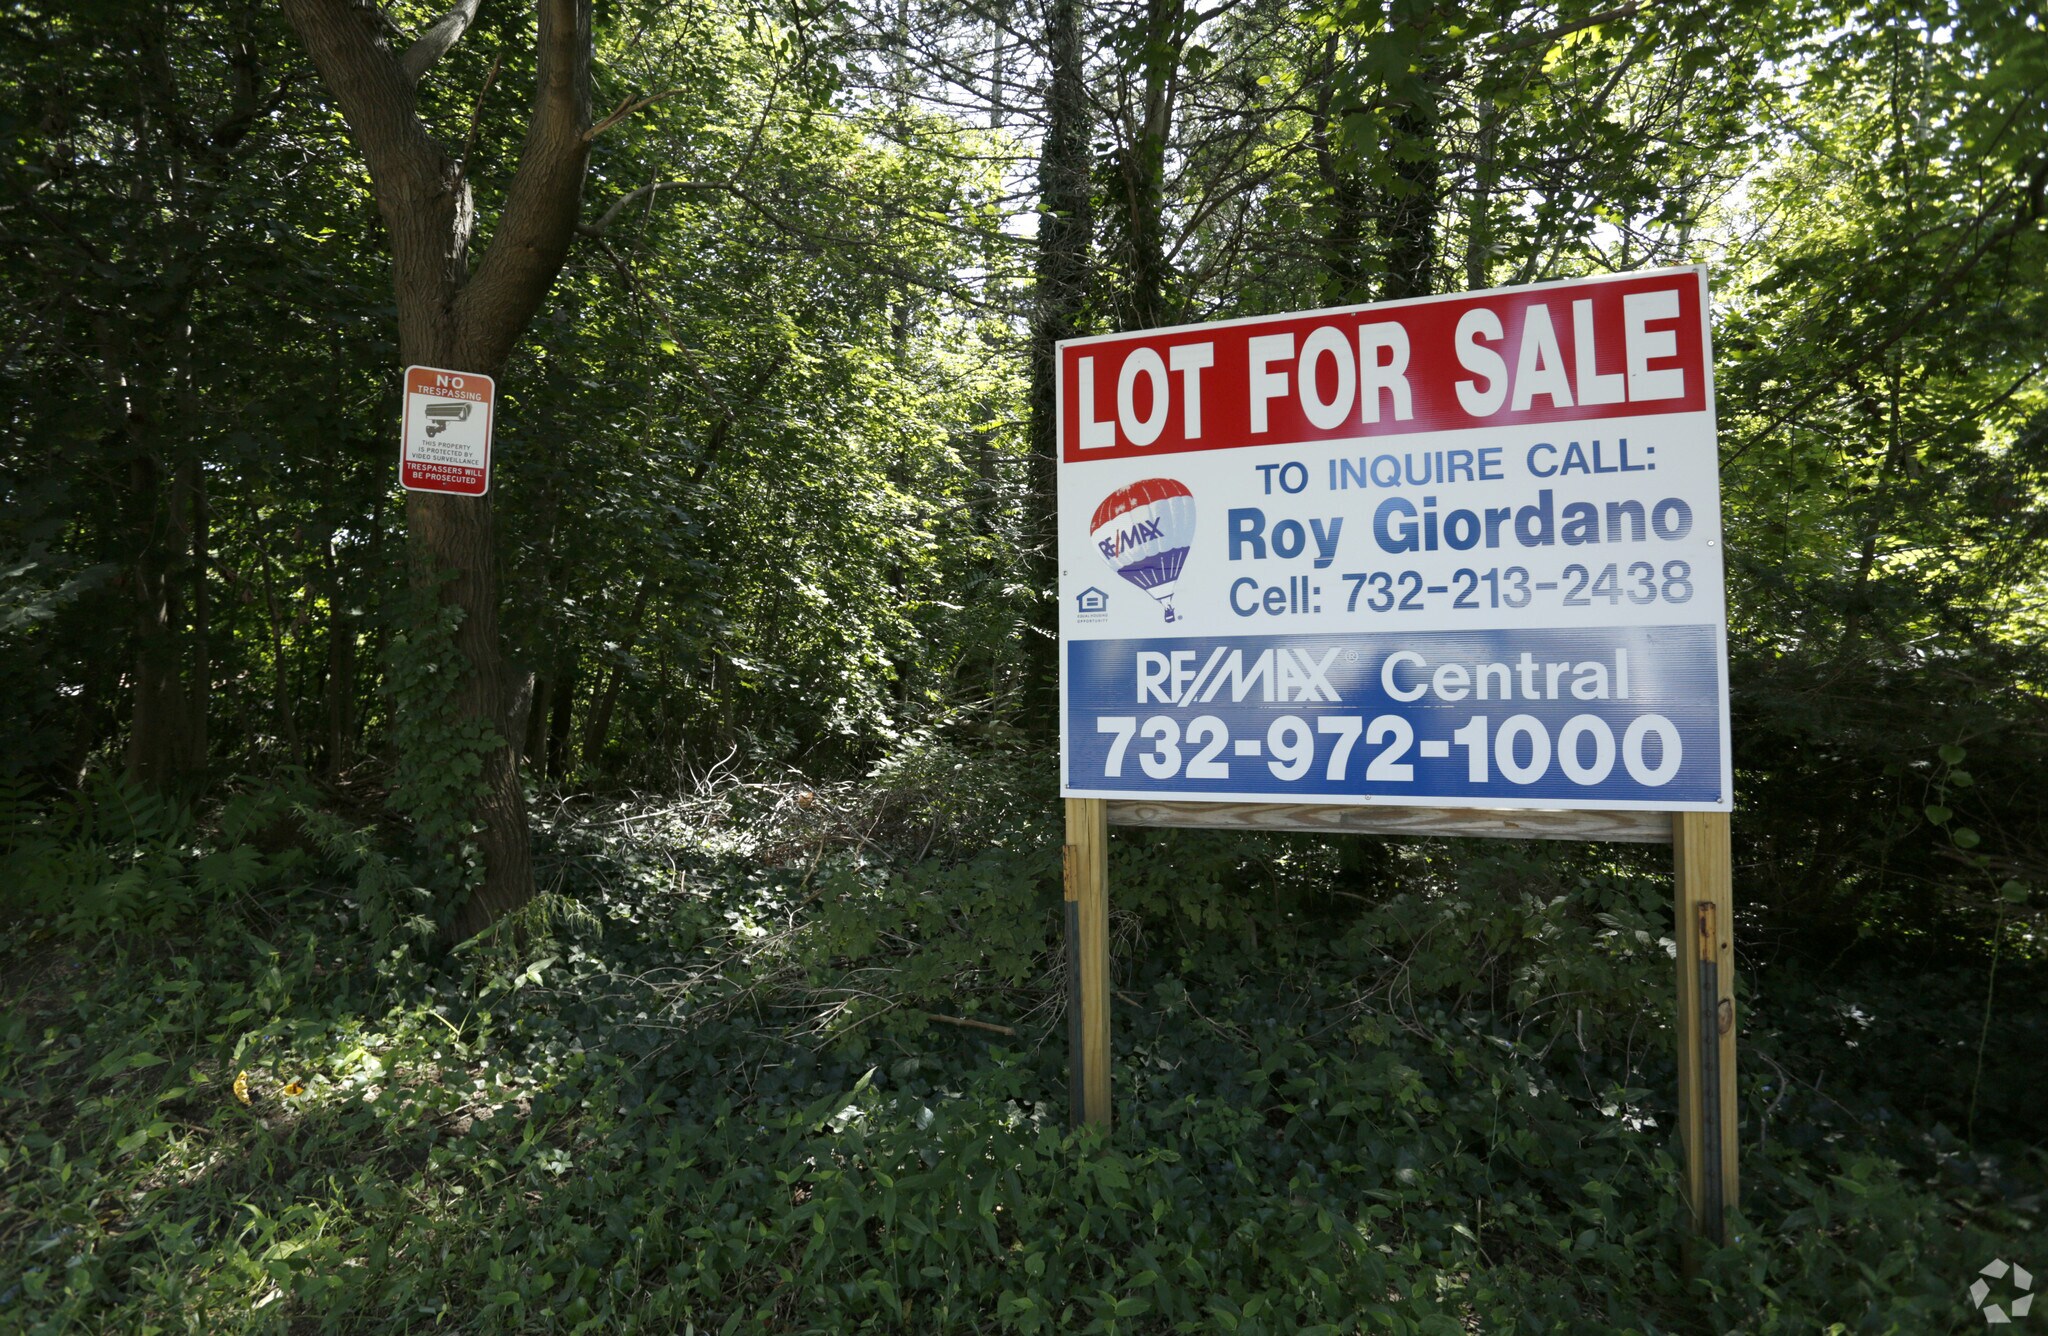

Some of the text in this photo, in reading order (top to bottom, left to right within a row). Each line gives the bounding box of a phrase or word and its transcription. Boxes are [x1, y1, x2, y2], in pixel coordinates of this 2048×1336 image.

[436, 374, 465, 389] NO
[1078, 289, 1686, 450] LOT FOR SALE
[417, 384, 482, 401] TRESPASSING
[426, 447, 463, 457] PROTECTED
[432, 455, 479, 465] SURVEILLANCE
[438, 442, 471, 450] PROPERTY
[407, 462, 483, 477] TRESPASSERS WILL
[412, 471, 476, 484] BE PROSECUTED
[1255, 437, 1657, 495] TO INQUIRE CALL:
[1098, 516, 1165, 560] RE/MAX
[1228, 488, 1693, 569] Roy Giordano
[1229, 559, 1695, 617] Cell: 732-213-2438
[1380, 648, 1629, 703] Central
[1096, 713, 1683, 788] 732-972-1000
